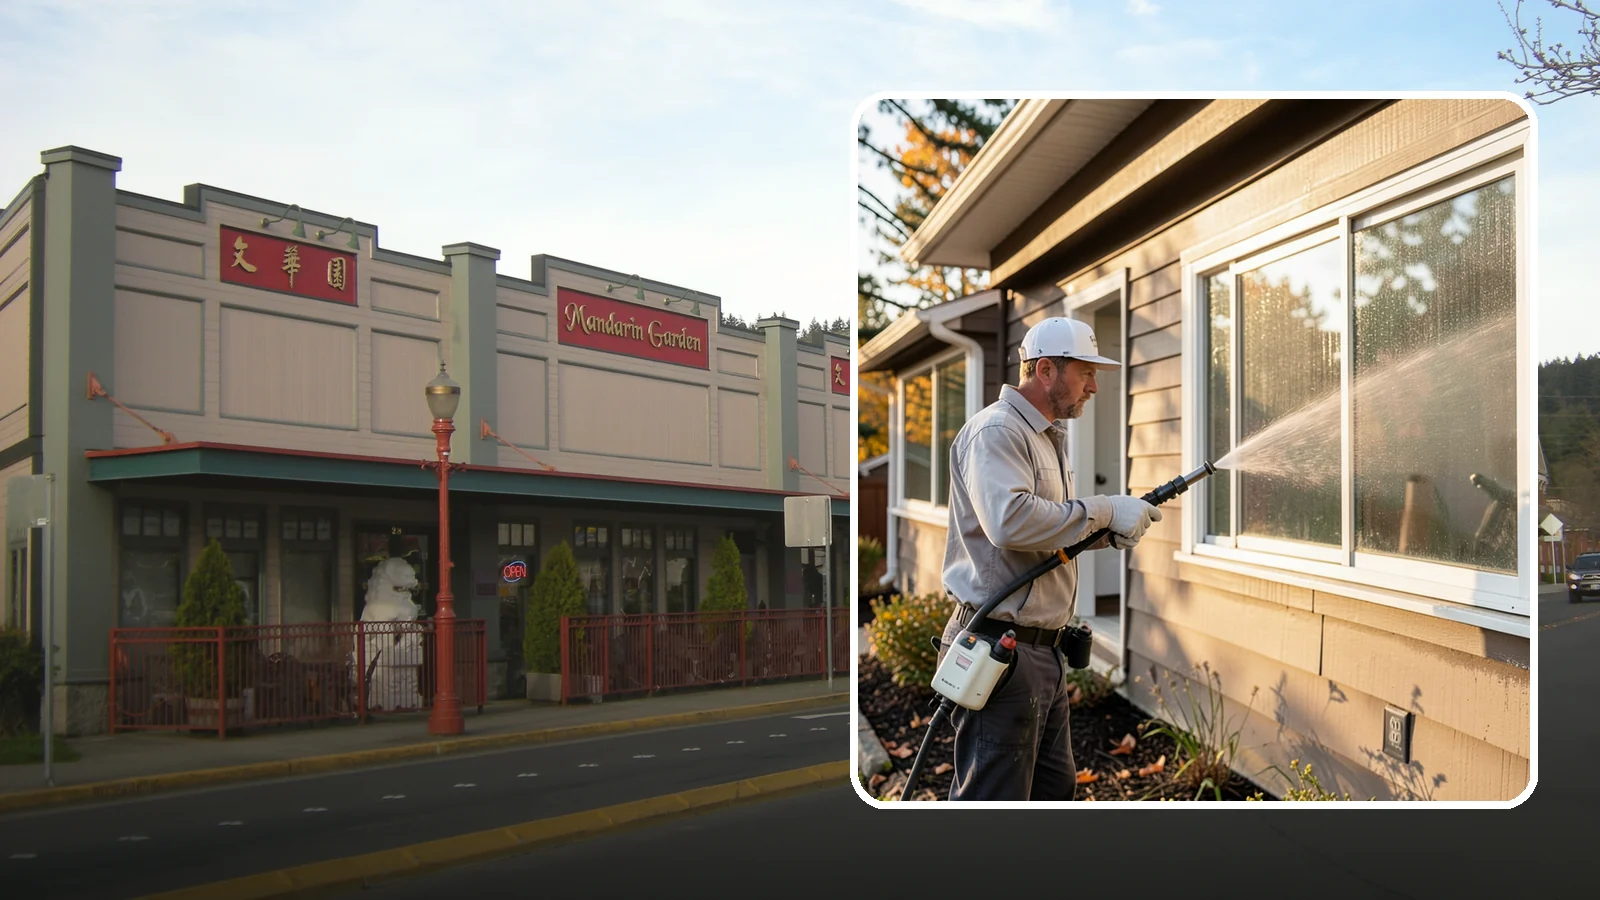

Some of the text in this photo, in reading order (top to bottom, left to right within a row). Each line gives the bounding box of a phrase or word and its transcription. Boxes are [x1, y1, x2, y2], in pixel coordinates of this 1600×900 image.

[231, 236, 346, 290] 文華園
[565, 302, 701, 352] Mandarin Garden
[503, 565, 527, 578] OPEN
